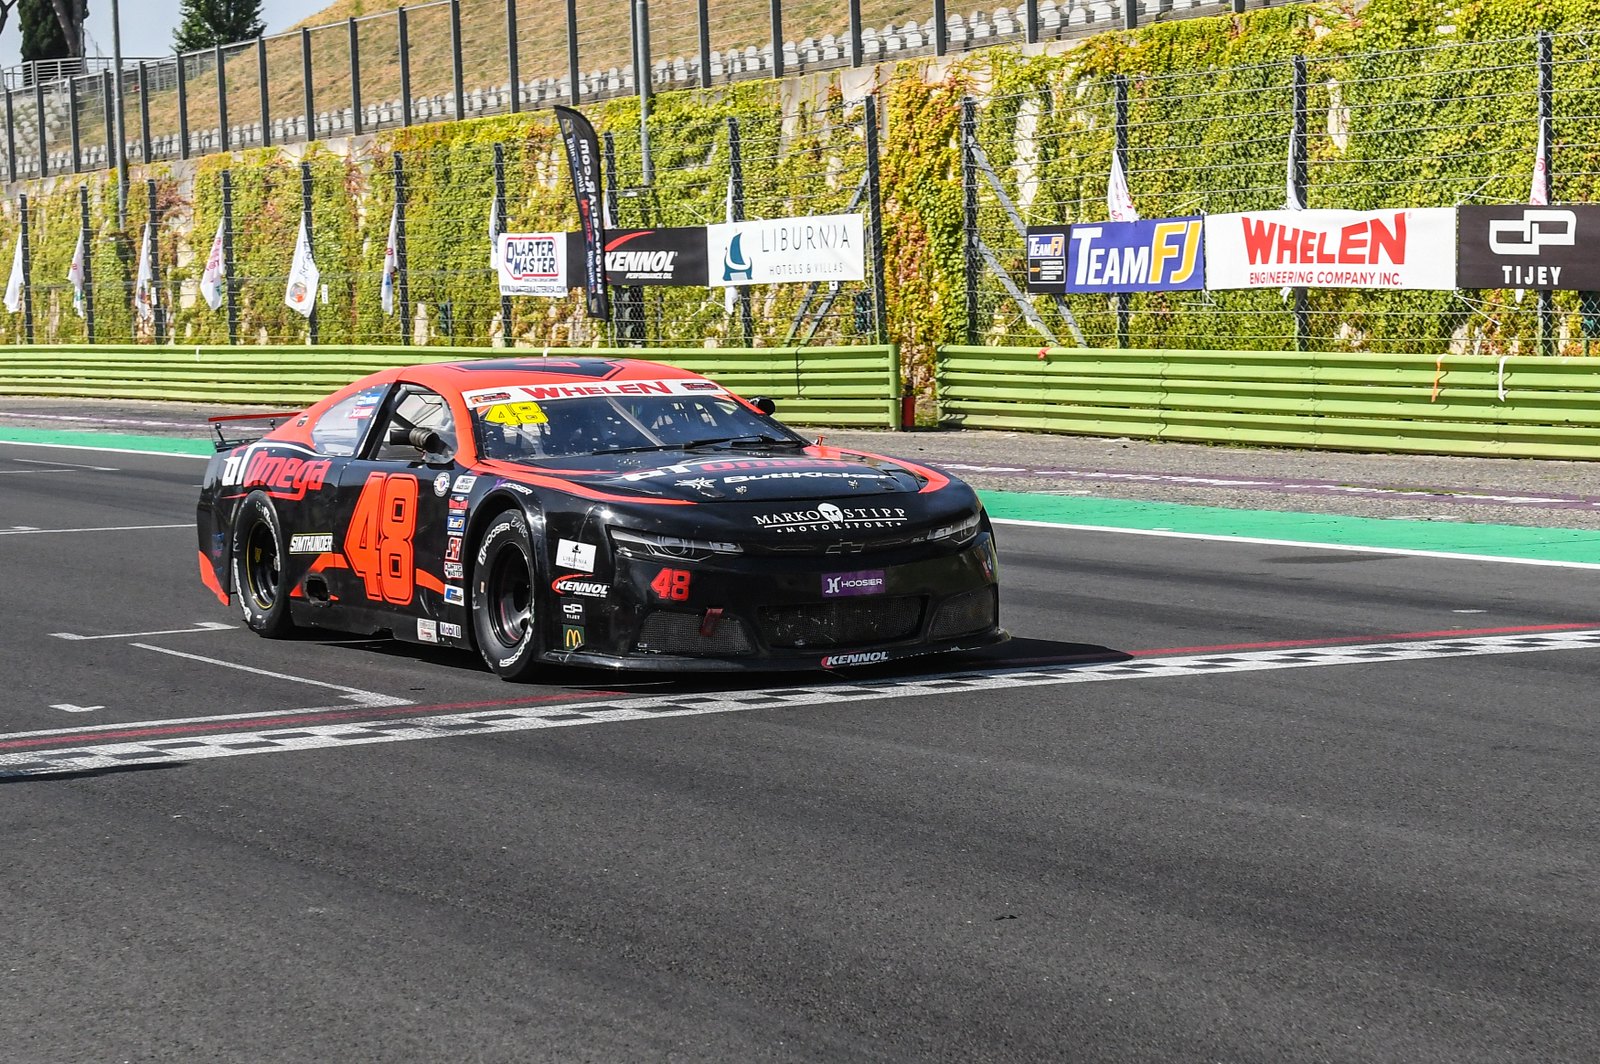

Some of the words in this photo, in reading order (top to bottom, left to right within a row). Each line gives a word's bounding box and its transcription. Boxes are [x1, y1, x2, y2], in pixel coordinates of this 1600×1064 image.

[761, 224, 851, 253] LIBURNIA
[1241, 212, 1407, 265] WHELEN
[505, 241, 554, 264] QUARTER
[513, 257, 556, 275] MASTER
[769, 263, 803, 276] HOTELS
[806, 263, 812, 275] &
[814, 262, 844, 274] VILLAS
[1501, 265, 1562, 286] TIJEY
[1249, 271, 1314, 285] ENGINEERING
[1316, 271, 1376, 285] COMPANY
[1378, 272, 1403, 286] INC.
[519, 380, 674, 401] WHELEN
[484, 401, 549, 427] 48
[752, 509, 821, 525] MARKO
[843, 507, 906, 520] STIPP
[785, 521, 893, 534] MOTORSPORT
[343, 471, 419, 606] 48
[555, 580, 609, 595] KENNOL
[650, 567, 692, 601] 48
[840, 578, 884, 589] HOOSIER
[826, 651, 889, 665] KENNOL
